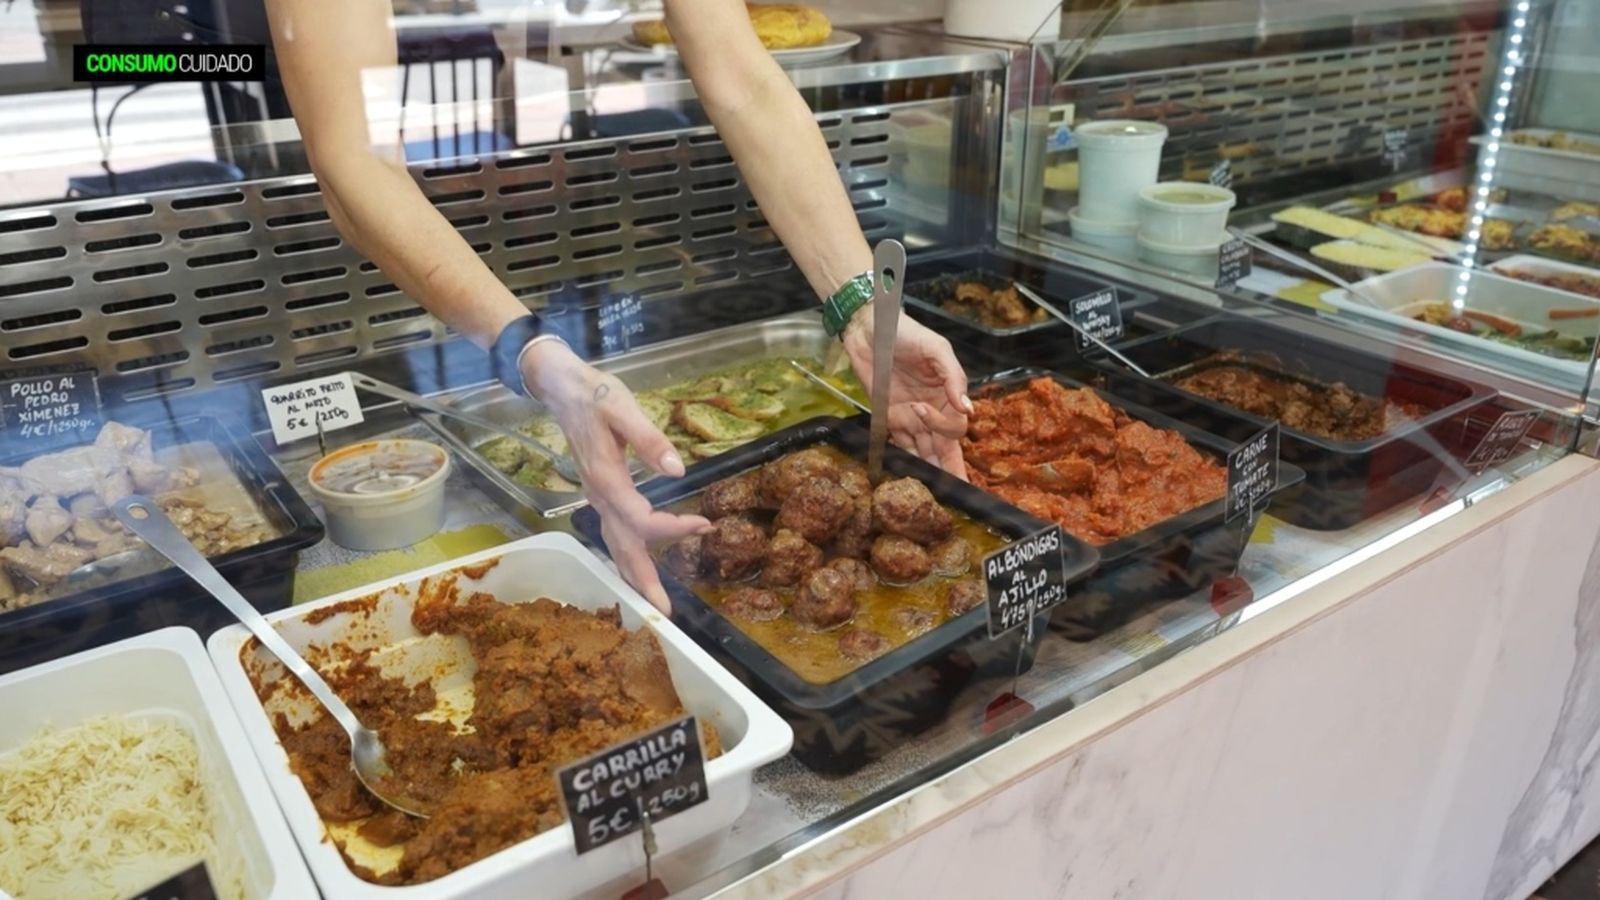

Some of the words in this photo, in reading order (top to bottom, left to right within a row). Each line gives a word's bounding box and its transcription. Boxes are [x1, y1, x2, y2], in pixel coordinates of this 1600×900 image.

[10, 380, 53, 398] POLLO
[59, 377, 76, 390] AL
[24, 391, 69, 409] PEDRO
[287, 404, 301, 415] AL
[1235, 433, 1268, 470] CARNE
[998, 568, 1048, 609] AJILLO
[1012, 570, 1027, 586] AL
[577, 790, 605, 813] AL
[609, 751, 686, 798] CURRY
